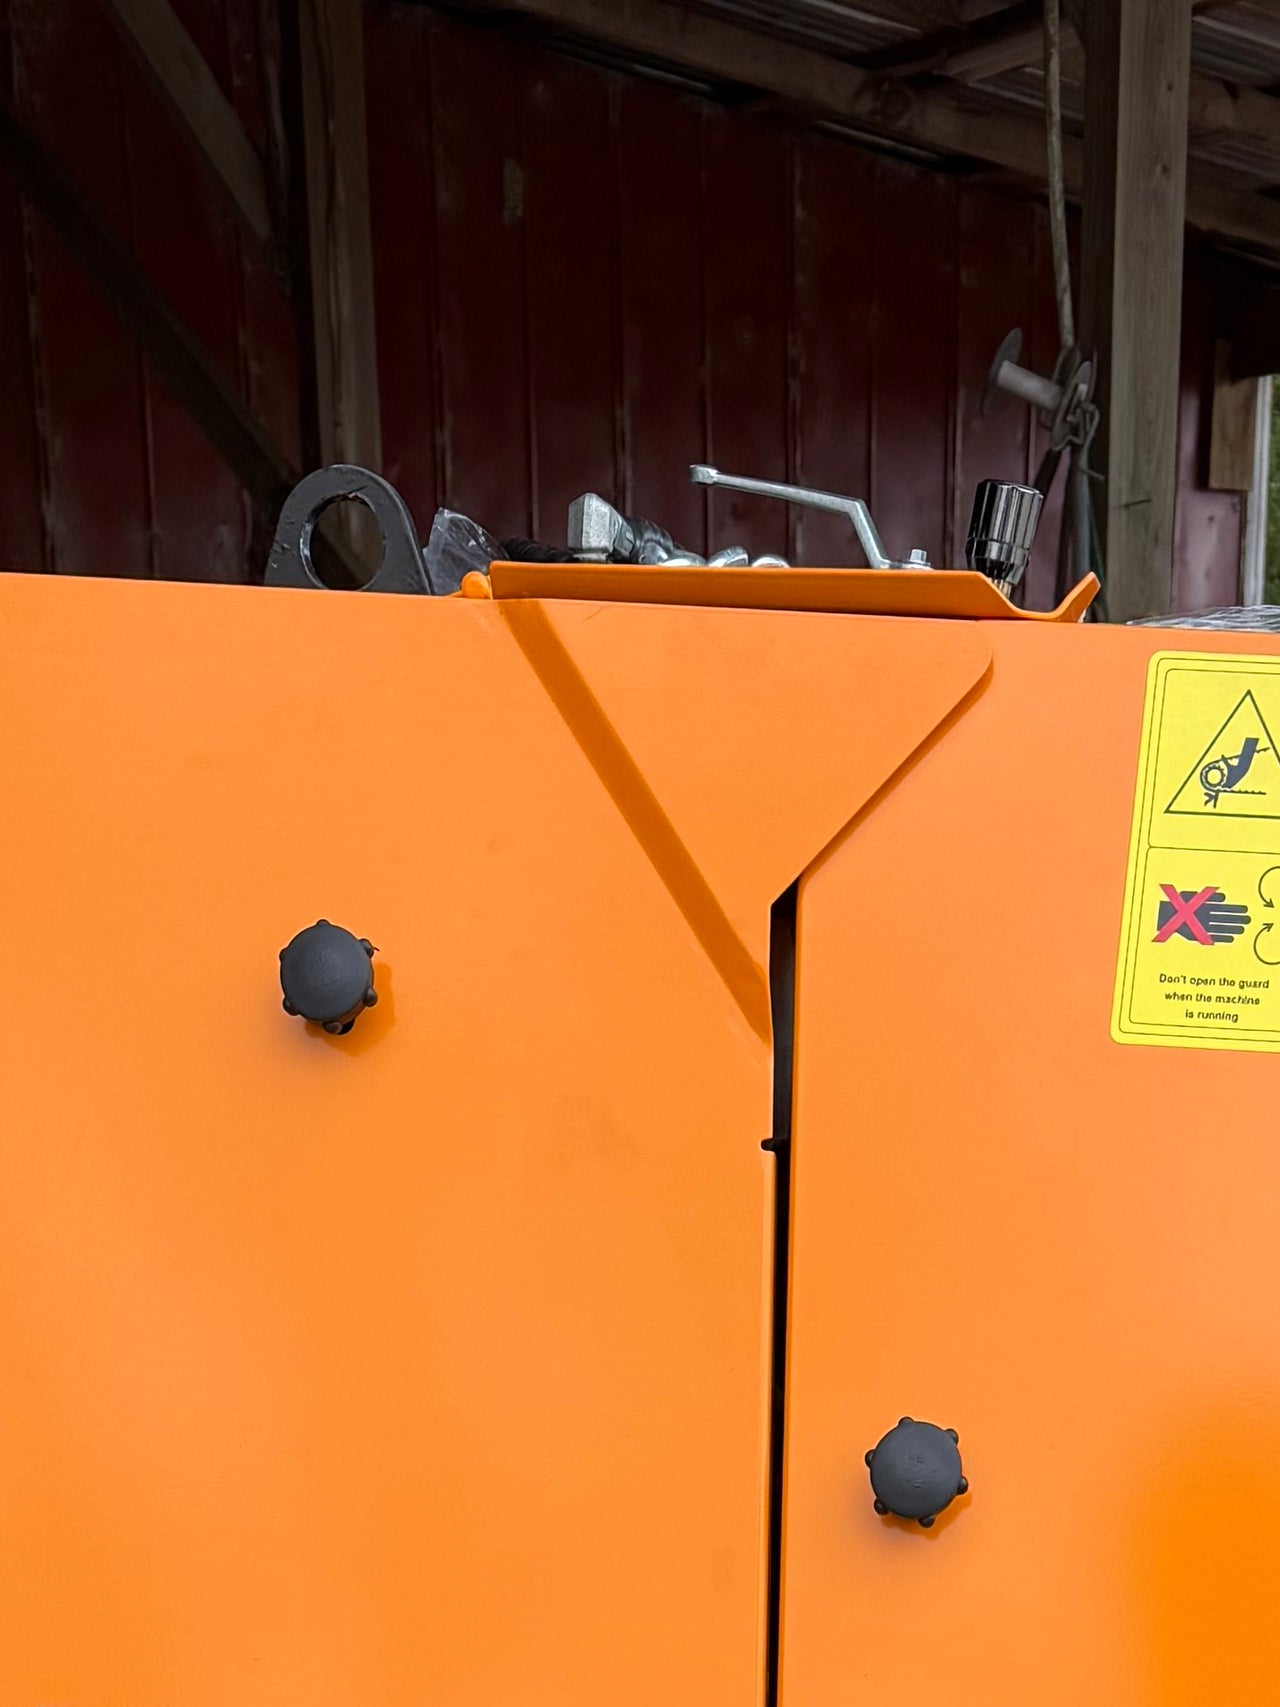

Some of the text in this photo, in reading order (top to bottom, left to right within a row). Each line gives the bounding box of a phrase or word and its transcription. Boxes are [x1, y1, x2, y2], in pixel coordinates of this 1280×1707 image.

[1159, 973, 1270, 990] Don't open the guard
[1164, 992, 1260, 1005] when the machine
[1185, 1009, 1239, 1023] is running
